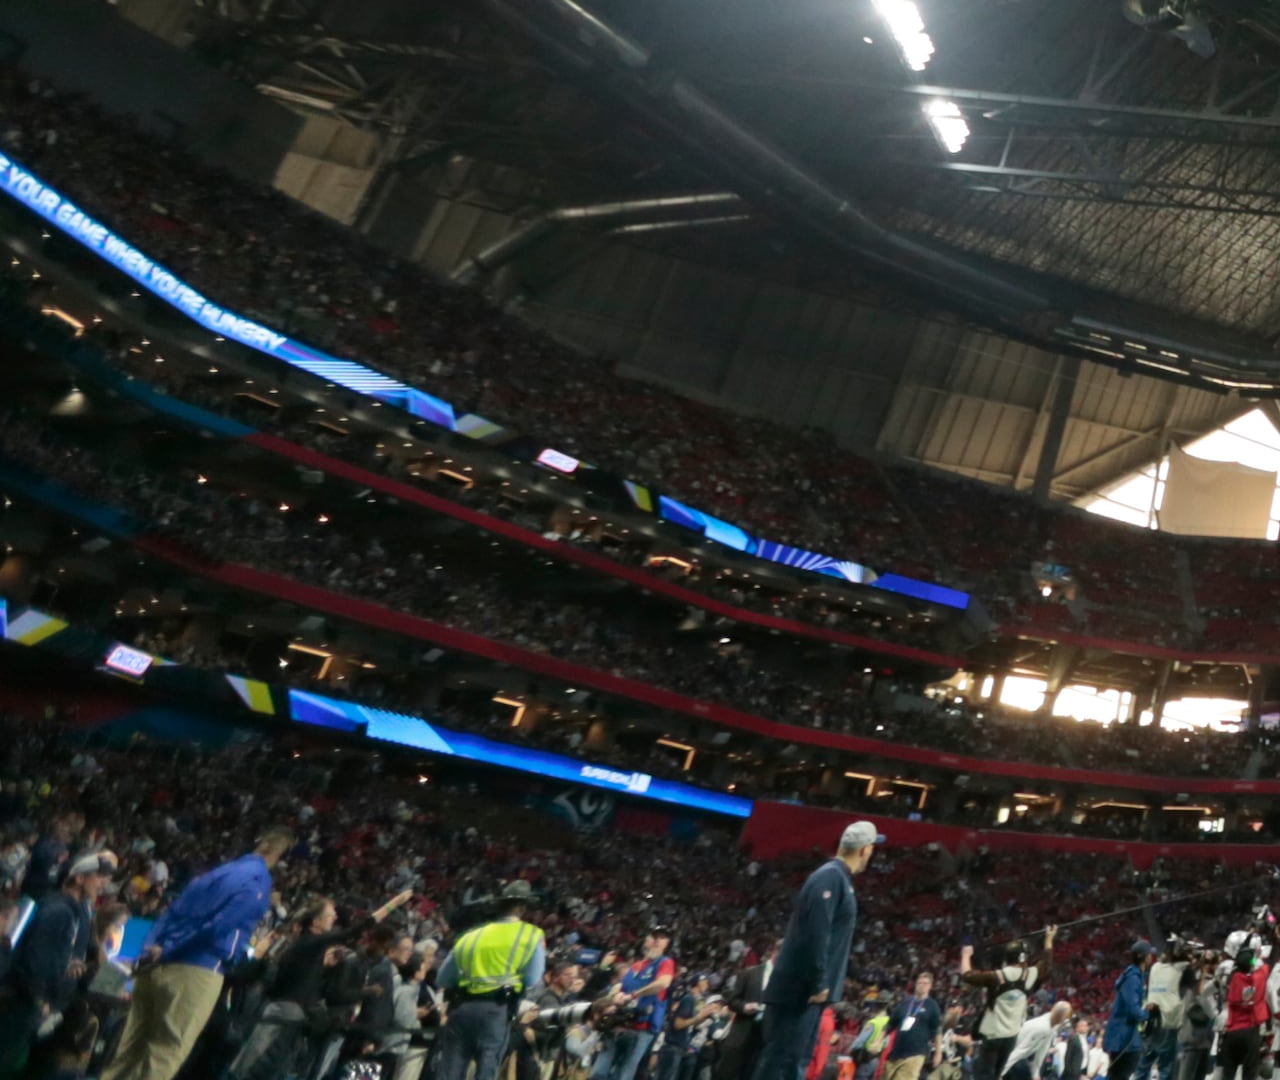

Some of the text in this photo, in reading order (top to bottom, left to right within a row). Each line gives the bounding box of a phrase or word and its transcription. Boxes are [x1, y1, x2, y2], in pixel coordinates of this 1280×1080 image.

[8, 166, 61, 213] YOUR
[56, 203, 108, 246] GAME
[104, 233, 154, 277] WHEN
